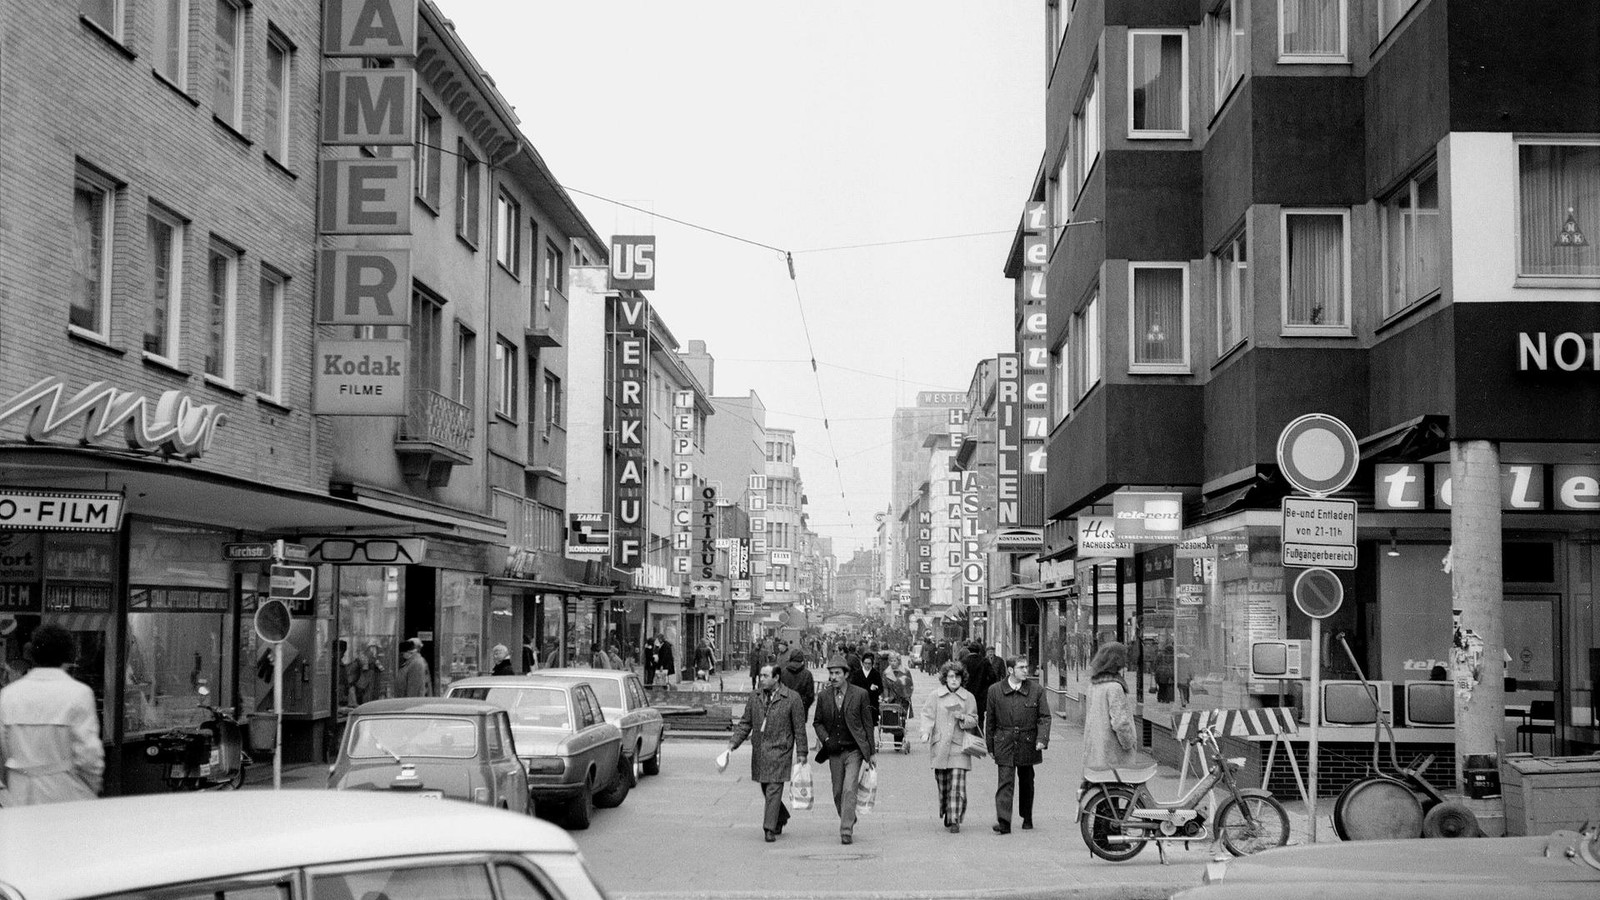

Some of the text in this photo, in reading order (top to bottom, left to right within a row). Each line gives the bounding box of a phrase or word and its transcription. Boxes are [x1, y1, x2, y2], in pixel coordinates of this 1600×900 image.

[343, 0, 406, 316] AMER
[612, 244, 654, 280] US
[322, 353, 401, 377] Kodak
[339, 384, 383, 396] FILME
[619, 301, 642, 565] VERKAUF
[999, 357, 1018, 523] BRILLEN
[676, 393, 690, 572] TEPPICHE
[950, 409, 963, 566] HELAND
[702, 487, 716, 579] OPTIKUS
[1117, 511, 1180, 519] telerent
[1296, 526, 1343, 537] von 21-11h
[1317, 509, 1354, 521] Entladen
[1285, 547, 1353, 562] Fußgängerbereich
